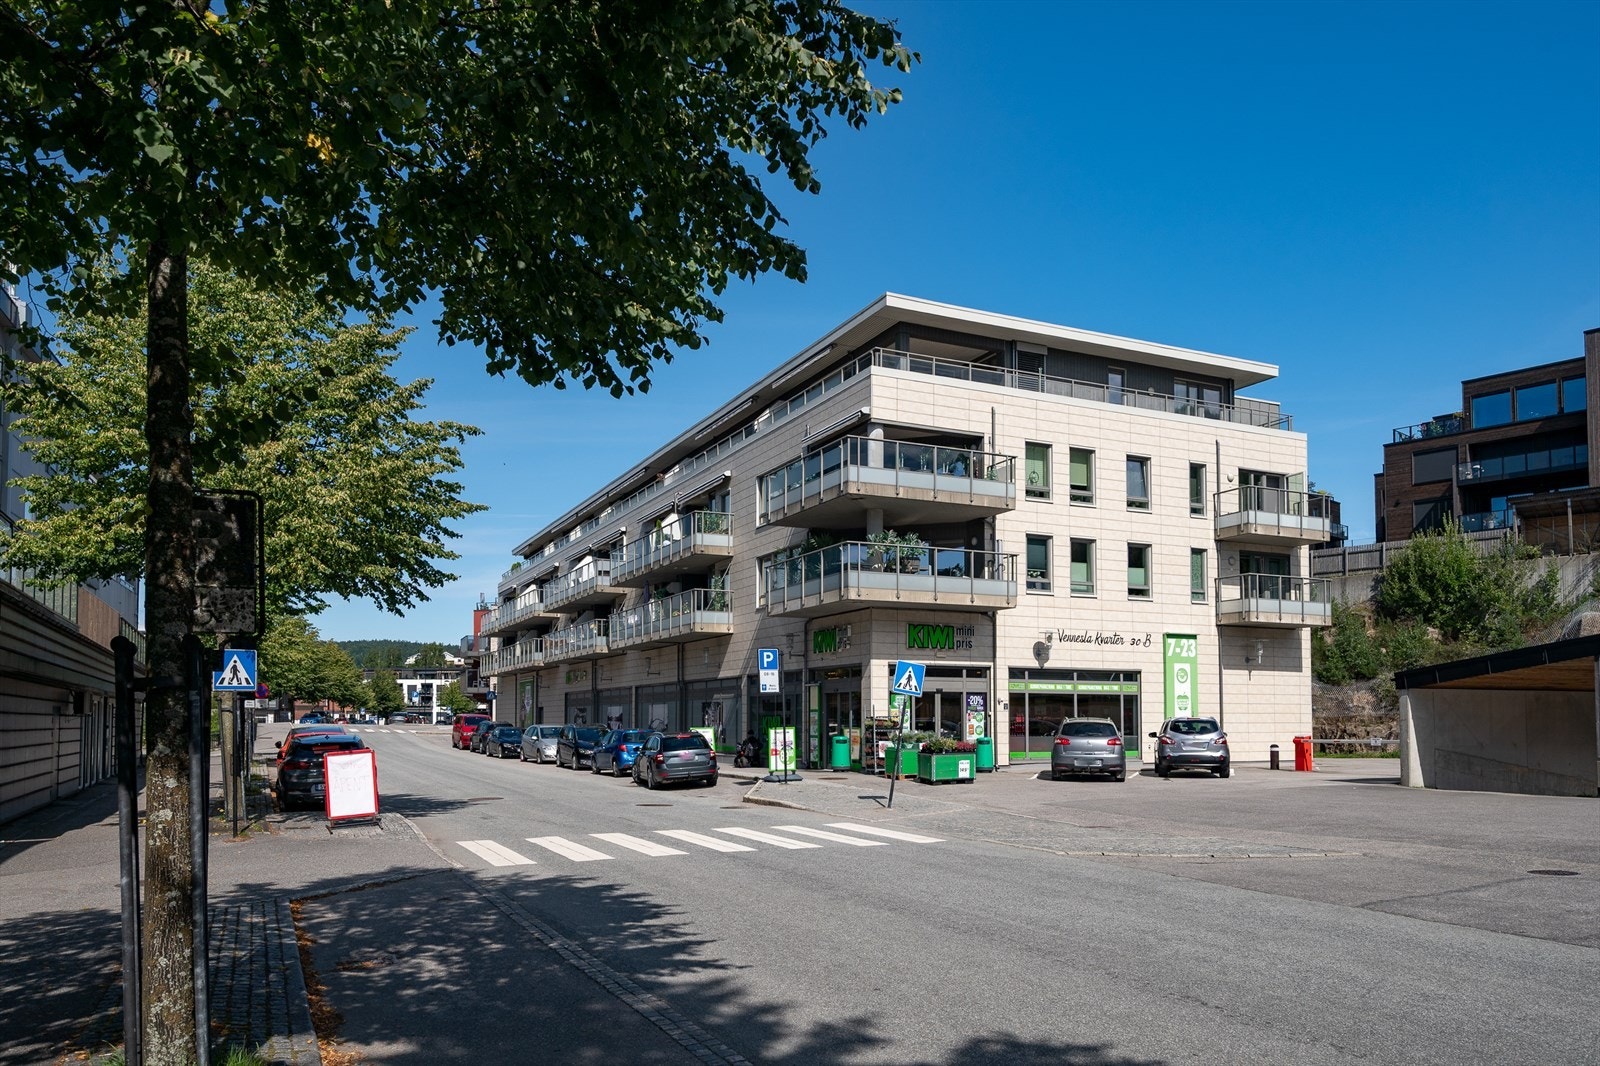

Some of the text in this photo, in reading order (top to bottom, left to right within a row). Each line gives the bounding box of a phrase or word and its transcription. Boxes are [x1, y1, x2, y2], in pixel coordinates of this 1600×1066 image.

[906, 623, 955, 650] KIWI
[956, 625, 975, 637] mini
[1057, 628, 1152, 648] Vennesla Kvarter 30 B
[813, 627, 837, 654] KIWI
[956, 638, 973, 650] pris
[1167, 638, 1196, 657] 7-23
[763, 652, 774, 668] P
[968, 695, 984, 705] -20%
